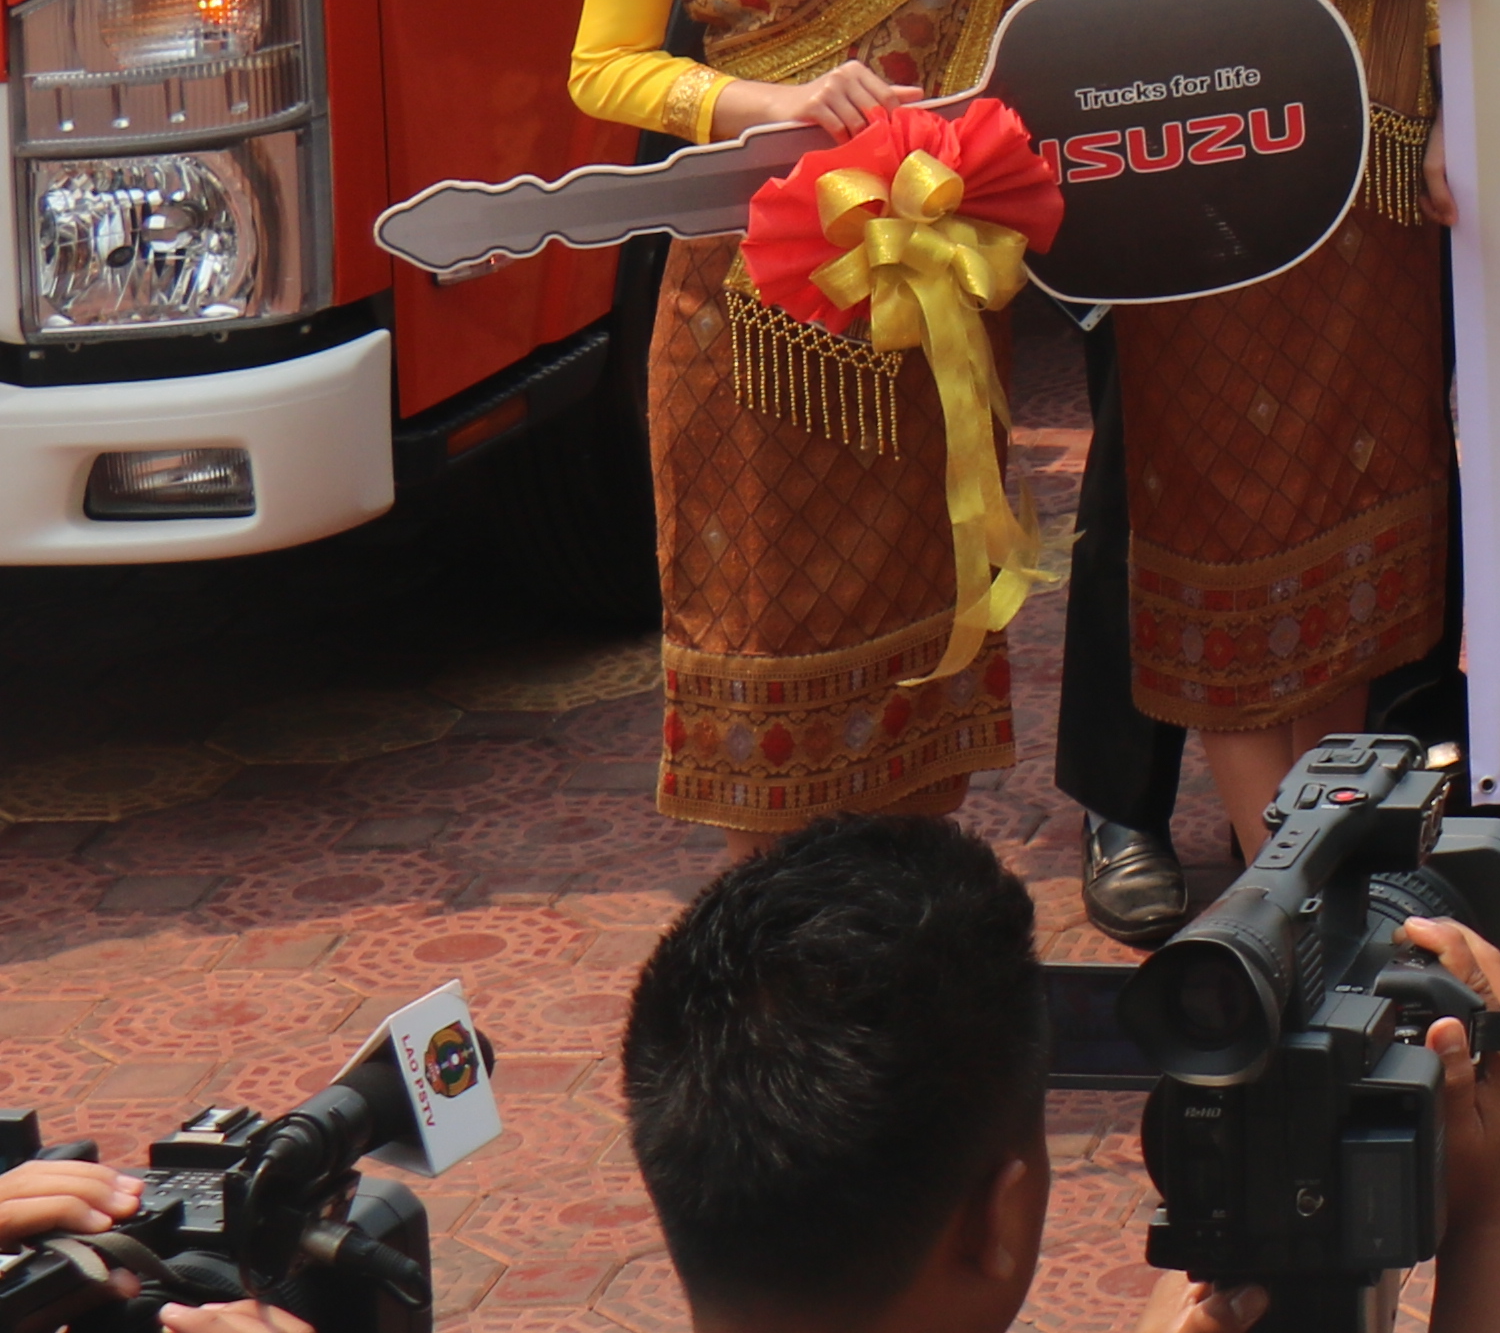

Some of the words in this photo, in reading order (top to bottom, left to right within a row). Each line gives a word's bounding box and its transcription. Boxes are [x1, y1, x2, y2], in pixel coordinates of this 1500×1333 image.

[1075, 80, 1167, 111] Trucks
[1170, 75, 1210, 97] for
[1214, 66, 1260, 92] life
[1039, 102, 1305, 185] ISUZU
[400, 1034, 420, 1073] LAO
[414, 1079, 436, 1128] PSTV
